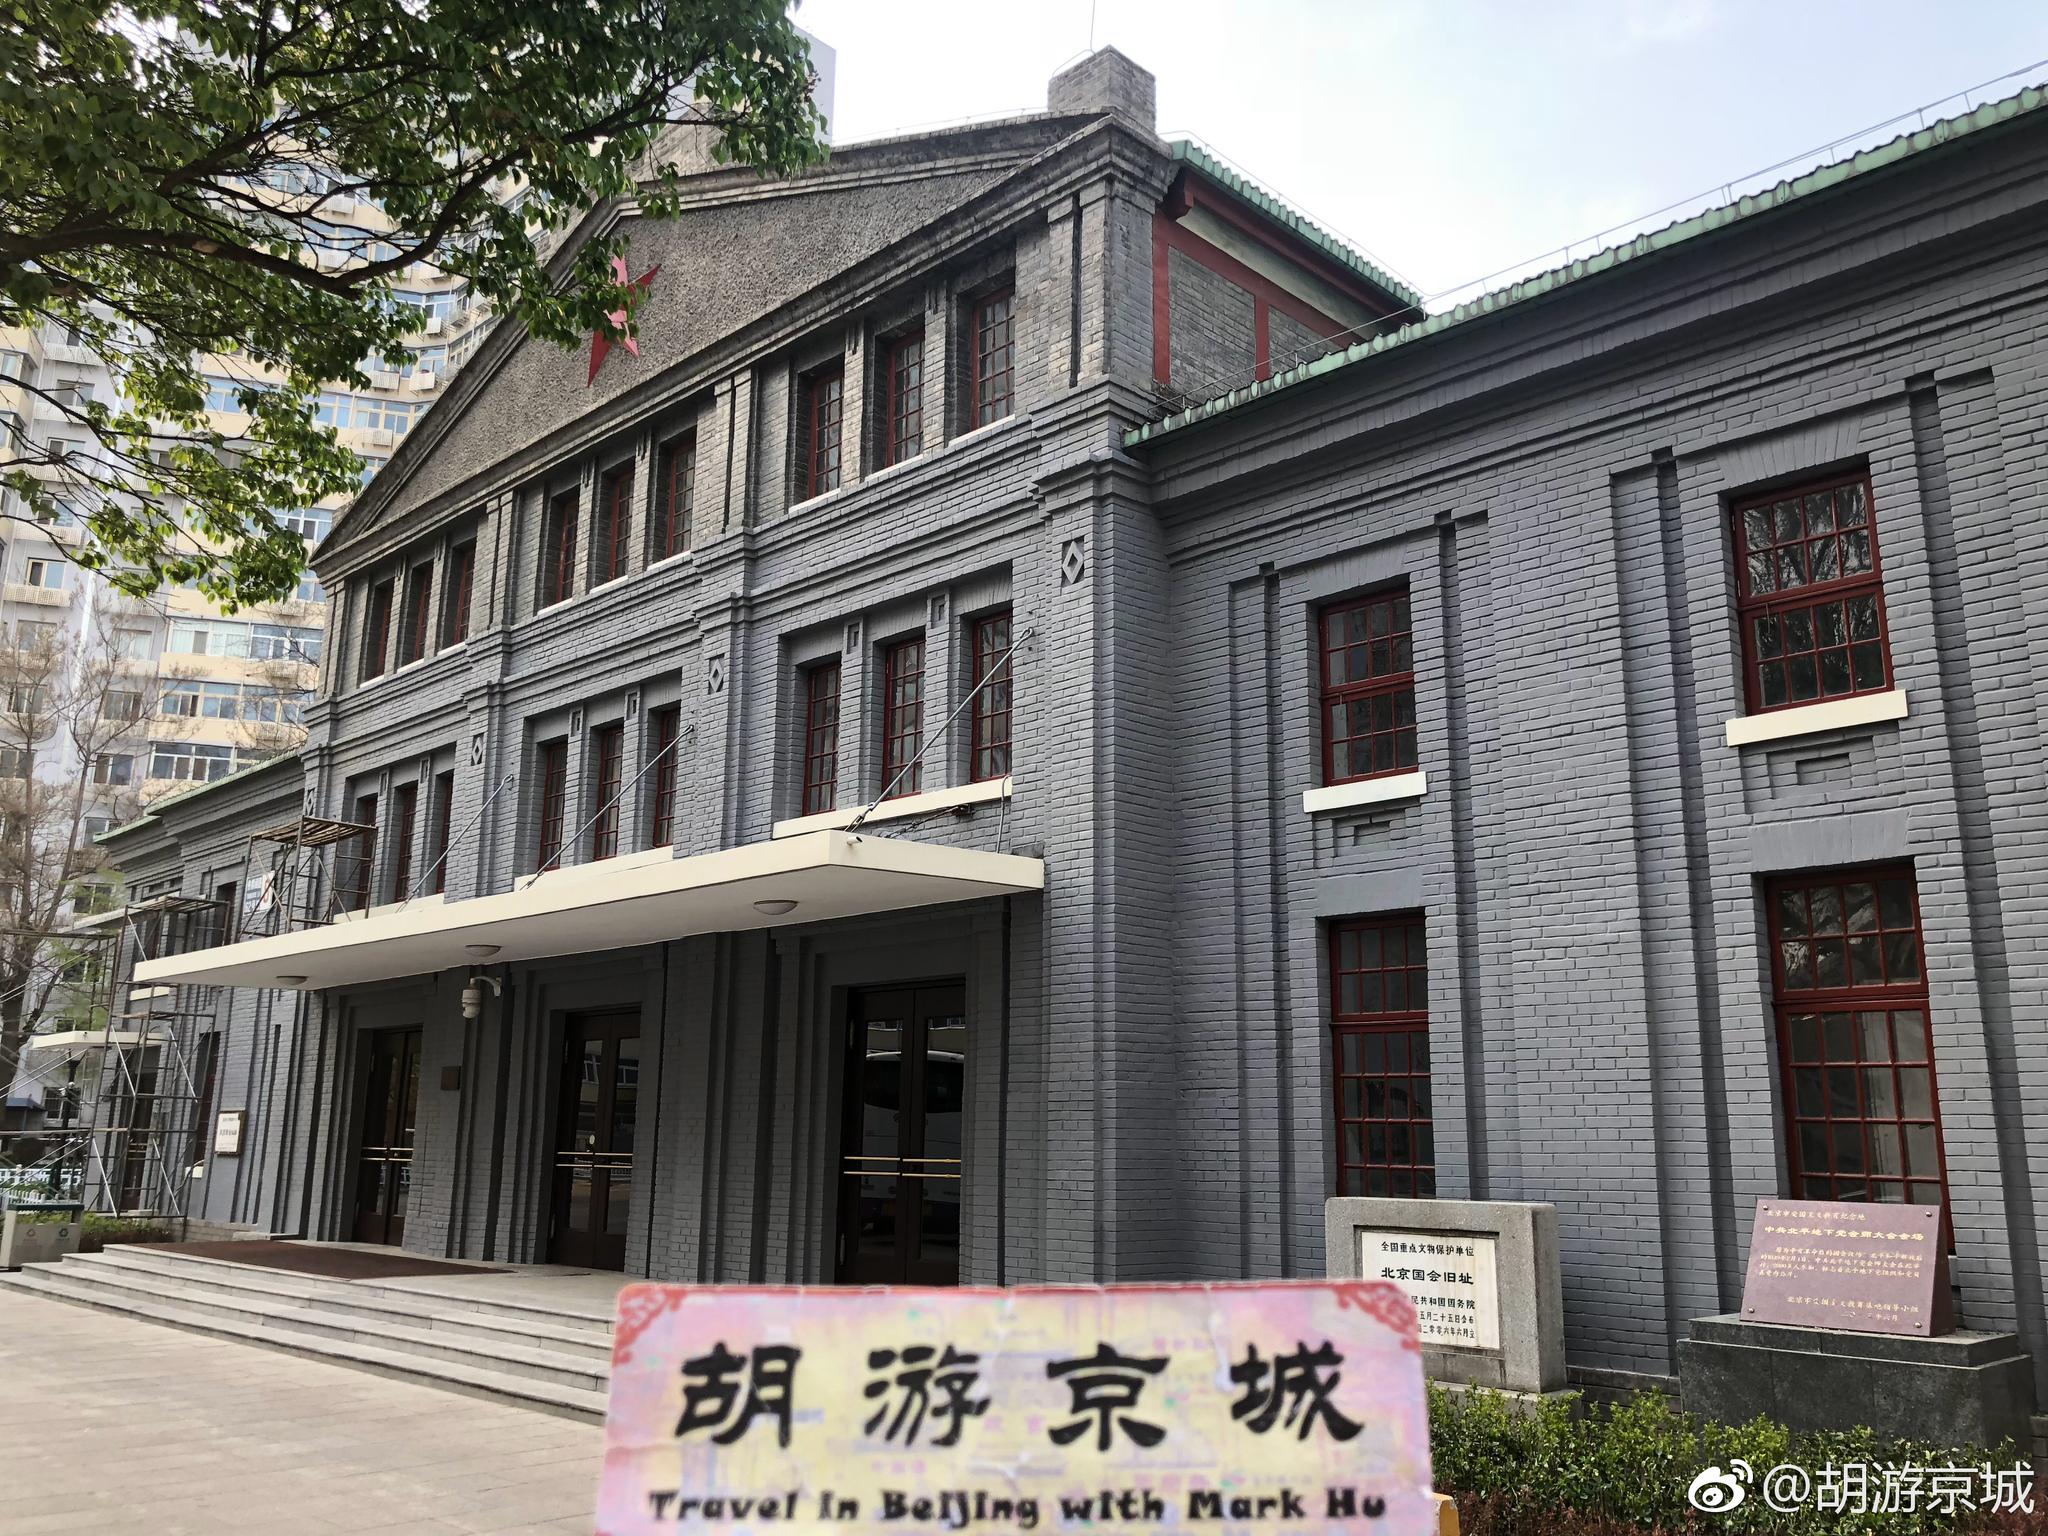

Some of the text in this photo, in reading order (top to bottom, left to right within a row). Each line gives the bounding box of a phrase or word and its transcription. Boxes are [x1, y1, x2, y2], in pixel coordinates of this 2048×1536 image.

[1764, 1225, 1925, 1241] 中共北平地下党会师大会会场
[1381, 1241, 1475, 1257] 全国重点文物保护单位
[1381, 1267, 1474, 1285] 北京国会旧址
[1411, 1295, 1475, 1310] 民共和国国务院
[676, 1341, 1364, 1452] 胡游京城
[648, 1487, 1386, 1529] Travel in Beijing with Mark Hu
